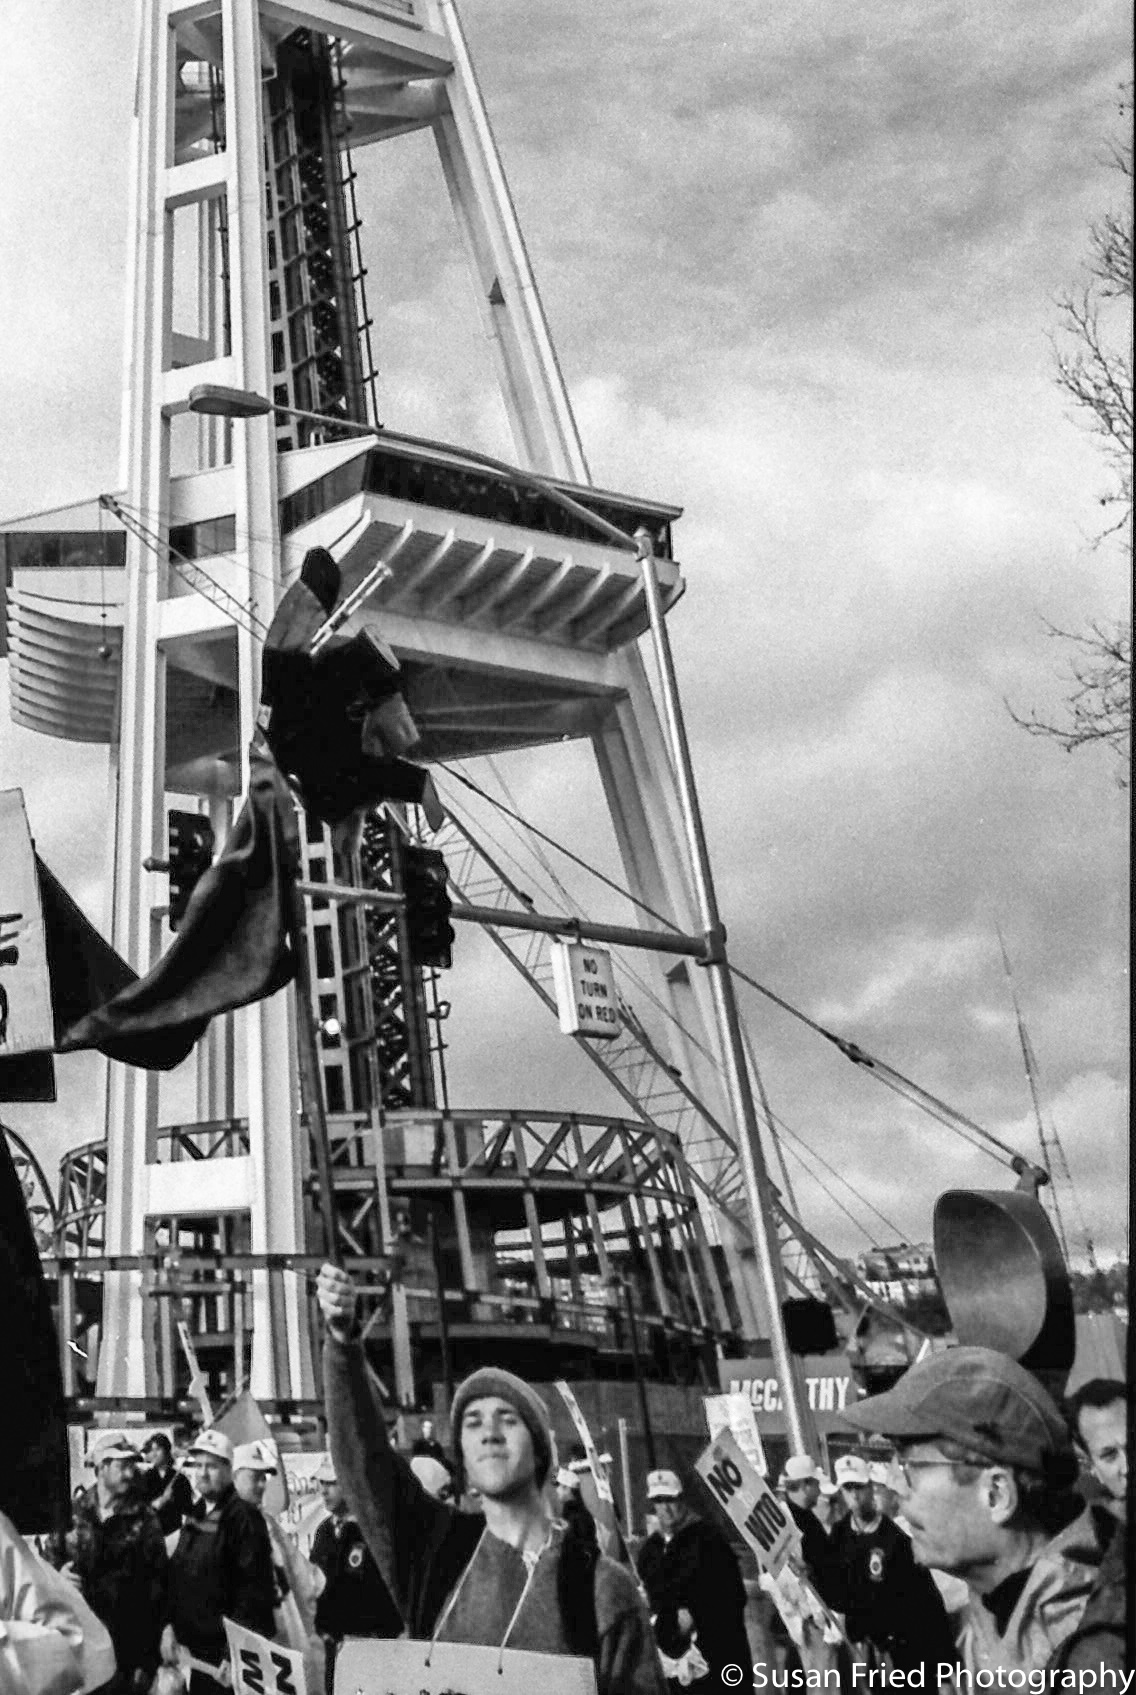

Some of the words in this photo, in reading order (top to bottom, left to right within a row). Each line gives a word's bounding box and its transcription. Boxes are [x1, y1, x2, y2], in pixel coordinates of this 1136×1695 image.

[582, 958, 599, 975] NO
[580, 980, 608, 999] TURN
[578, 1003, 593, 1020] ON
[595, 1005, 616, 1024] RED
[706, 1456, 743, 1505] NO
[744, 1492, 787, 1553] WTO
